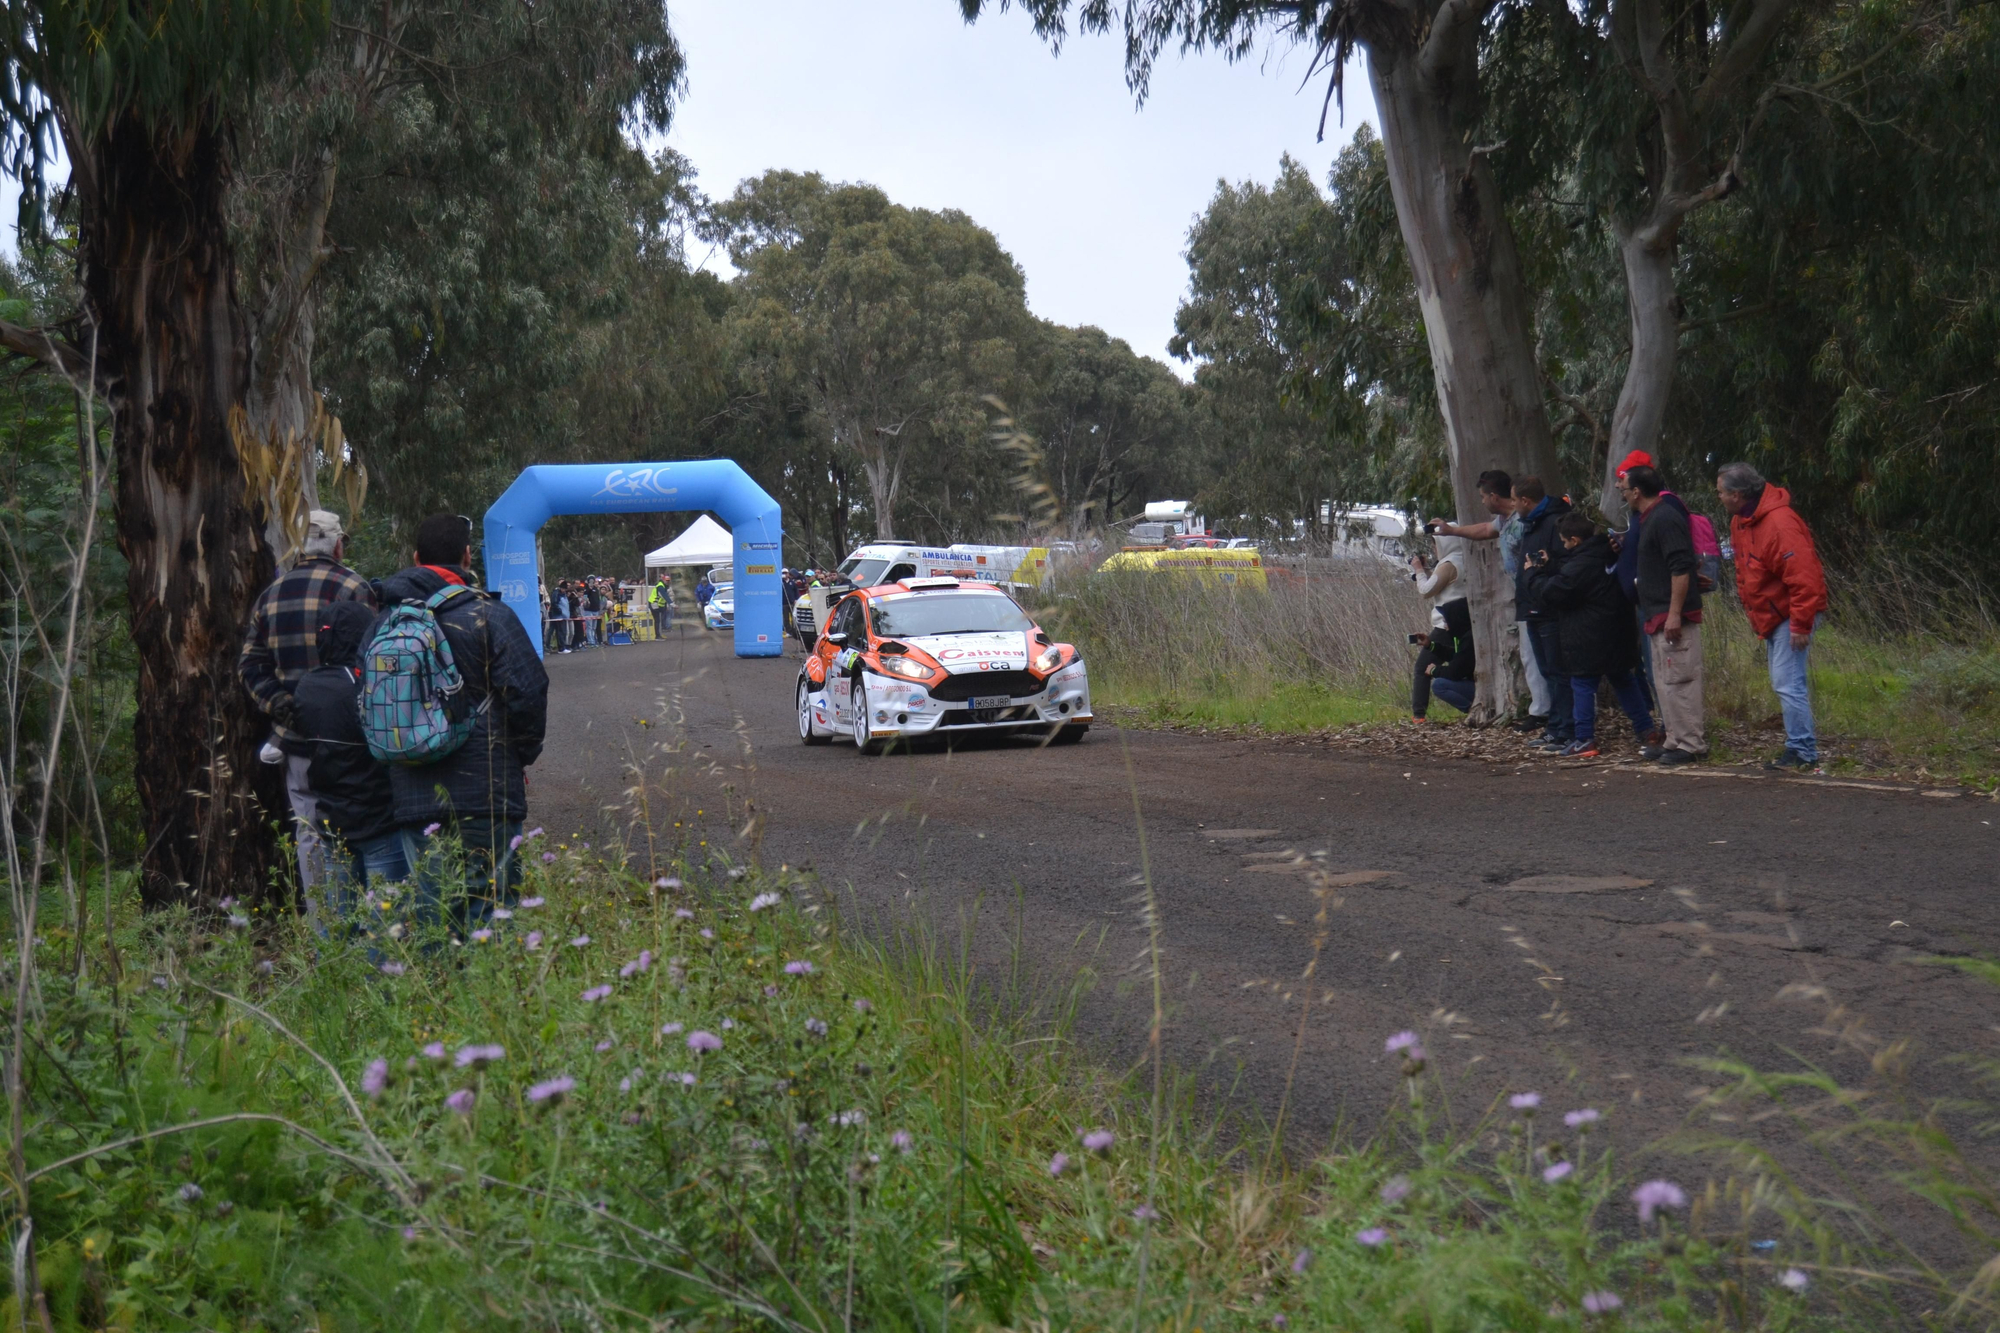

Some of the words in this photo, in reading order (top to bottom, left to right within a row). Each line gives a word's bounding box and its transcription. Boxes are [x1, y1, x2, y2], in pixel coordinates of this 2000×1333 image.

[592, 468, 678, 497] ERC
[922, 551, 973, 561] AMBULANCIA
[500, 585, 526, 598] FIA
[938, 648, 1022, 660] Caisven
